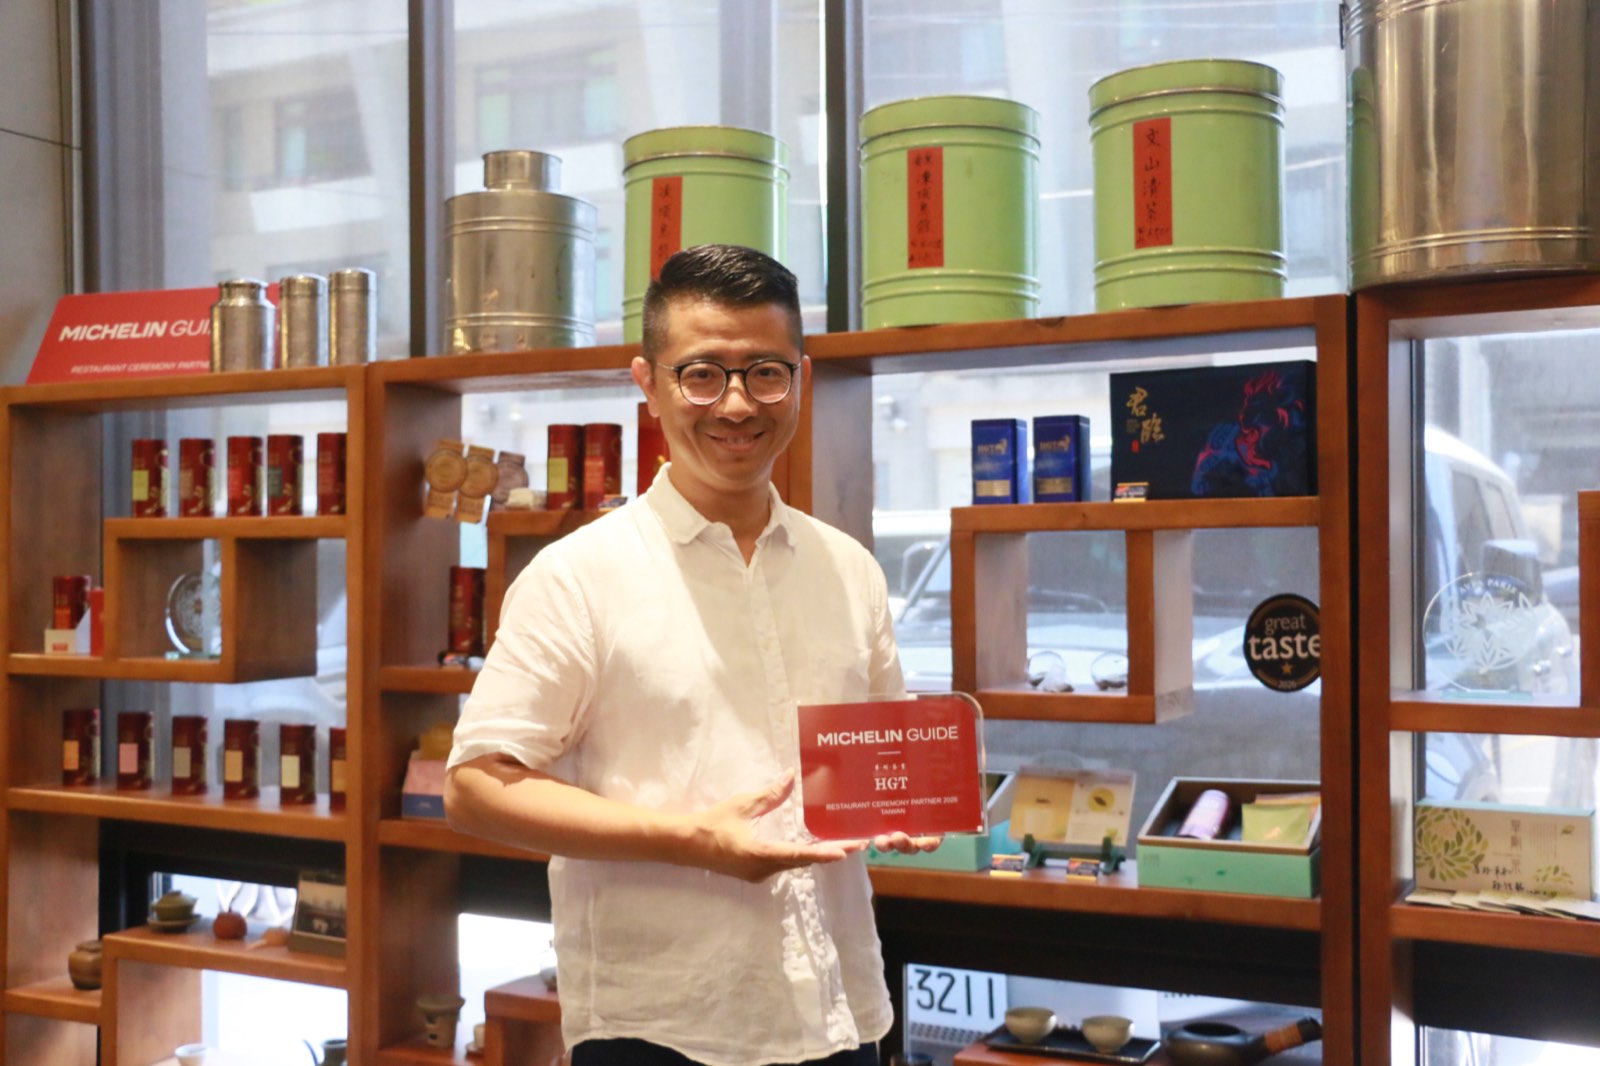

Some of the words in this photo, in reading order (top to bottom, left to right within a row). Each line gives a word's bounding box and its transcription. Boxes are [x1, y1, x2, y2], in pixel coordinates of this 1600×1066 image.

[59, 321, 168, 342] MICHELIN
[170, 319, 211, 337] GUI
[71, 363, 126, 374] RESTAURANT
[127, 362, 176, 372] CEREMONY
[1264, 613, 1307, 635] great
[1248, 632, 1320, 660] taste
[817, 729, 903, 747] MICHELIN
[906, 726, 959, 742] GUIDE
[874, 776, 908, 791] HGT
[826, 801, 870, 811] RESTAURANT
[871, 799, 909, 808] CEREMONY
[911, 798, 942, 806] PARTNER
[880, 808, 905, 816] TAIWAN
